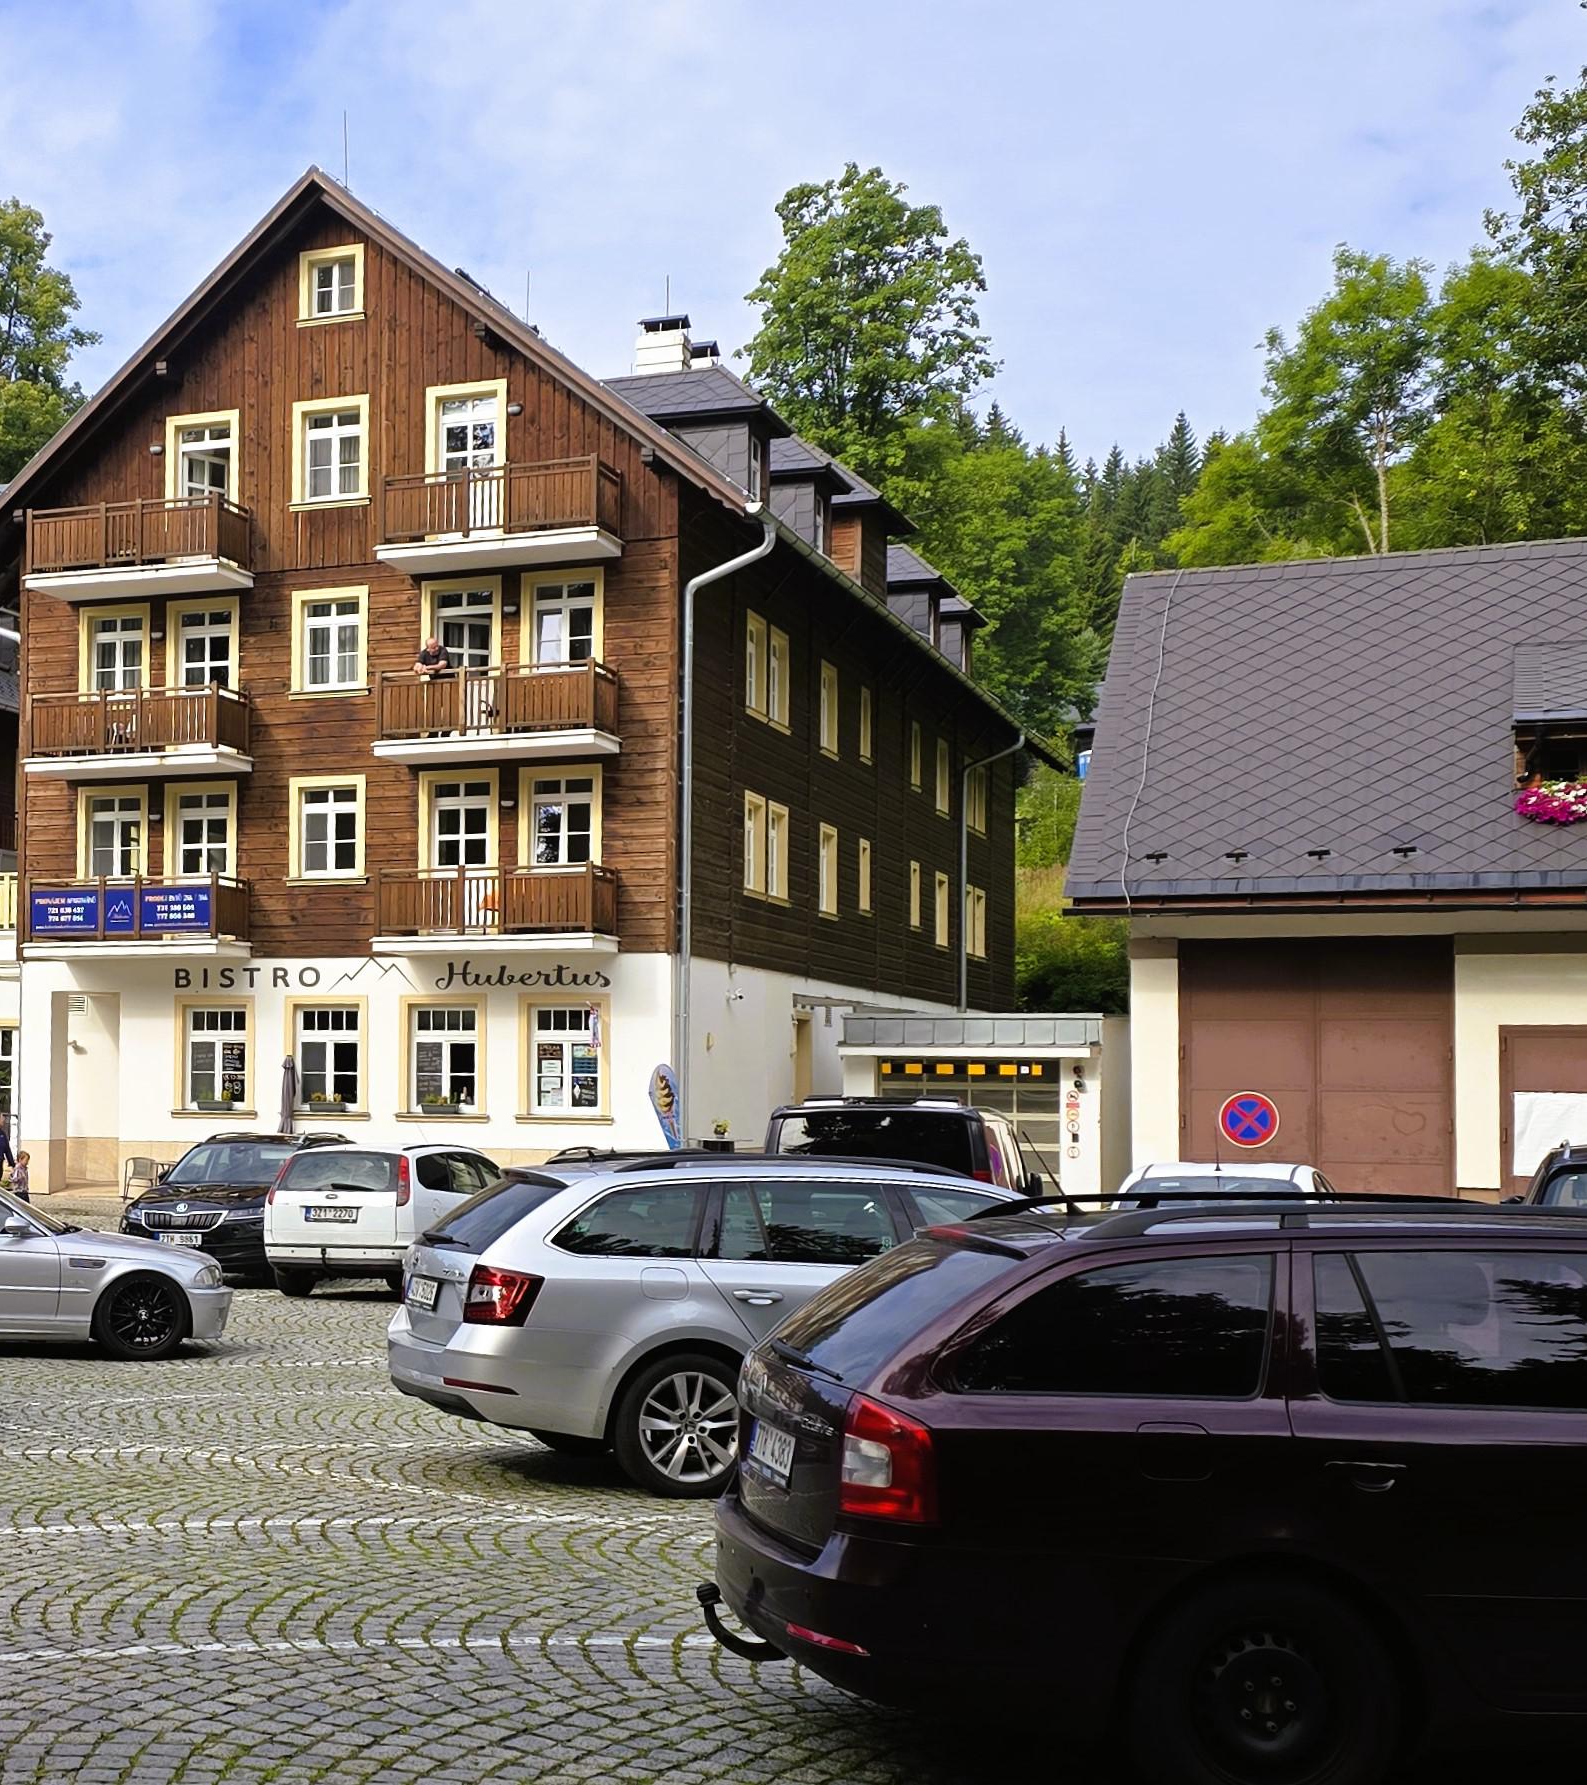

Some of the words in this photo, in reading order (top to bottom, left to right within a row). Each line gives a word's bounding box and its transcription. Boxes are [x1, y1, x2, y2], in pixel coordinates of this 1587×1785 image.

[174, 966, 321, 989] BISTRO
[434, 960, 612, 990] Hubertus
[331, 1208, 354, 1219] 2270
